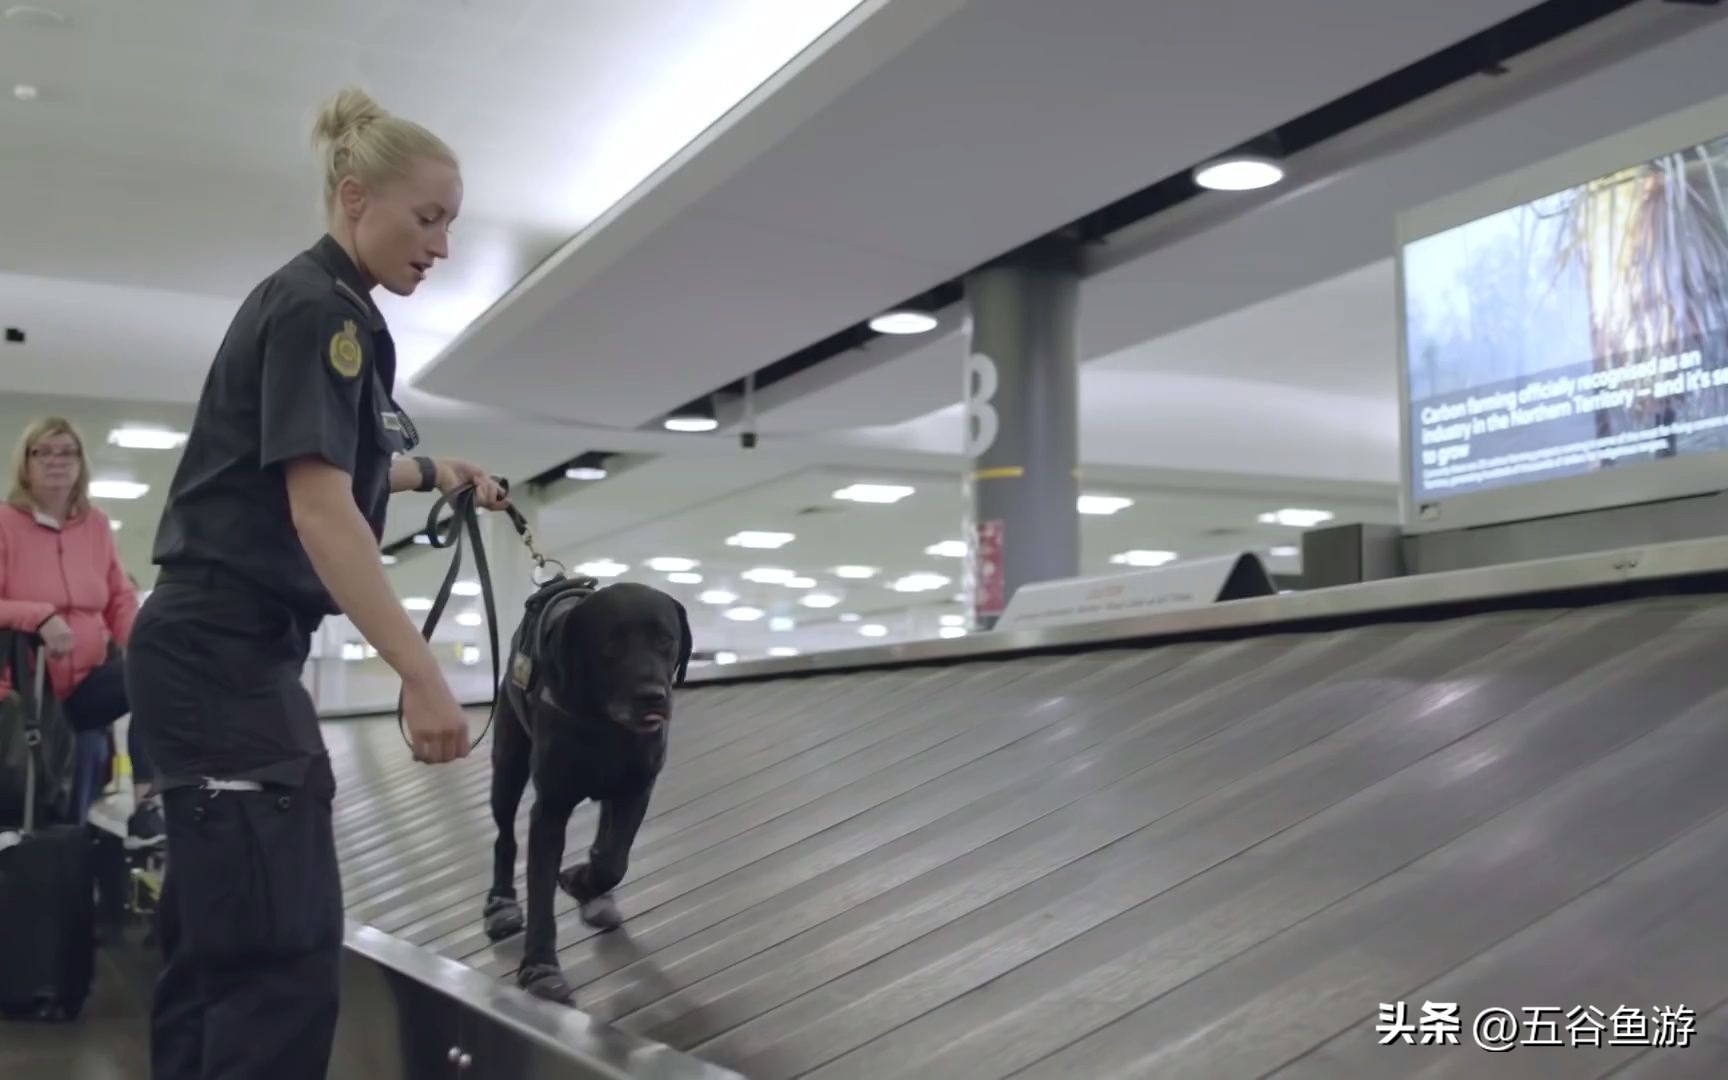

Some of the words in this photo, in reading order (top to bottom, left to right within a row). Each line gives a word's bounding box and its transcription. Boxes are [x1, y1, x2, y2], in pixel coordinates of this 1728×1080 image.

[1518, 378, 1575, 403] officially
[1659, 355, 1677, 374] as
[1680, 351, 1701, 369] an
[1422, 422, 1472, 445] industry
[1472, 416, 1486, 435] in
[1487, 413, 1509, 433] the
[1511, 402, 1571, 426] Northern
[1573, 389, 1633, 414] Territory
[1653, 372, 1684, 398] and
[1422, 450, 1437, 465] to
[1437, 444, 1470, 467] grow
